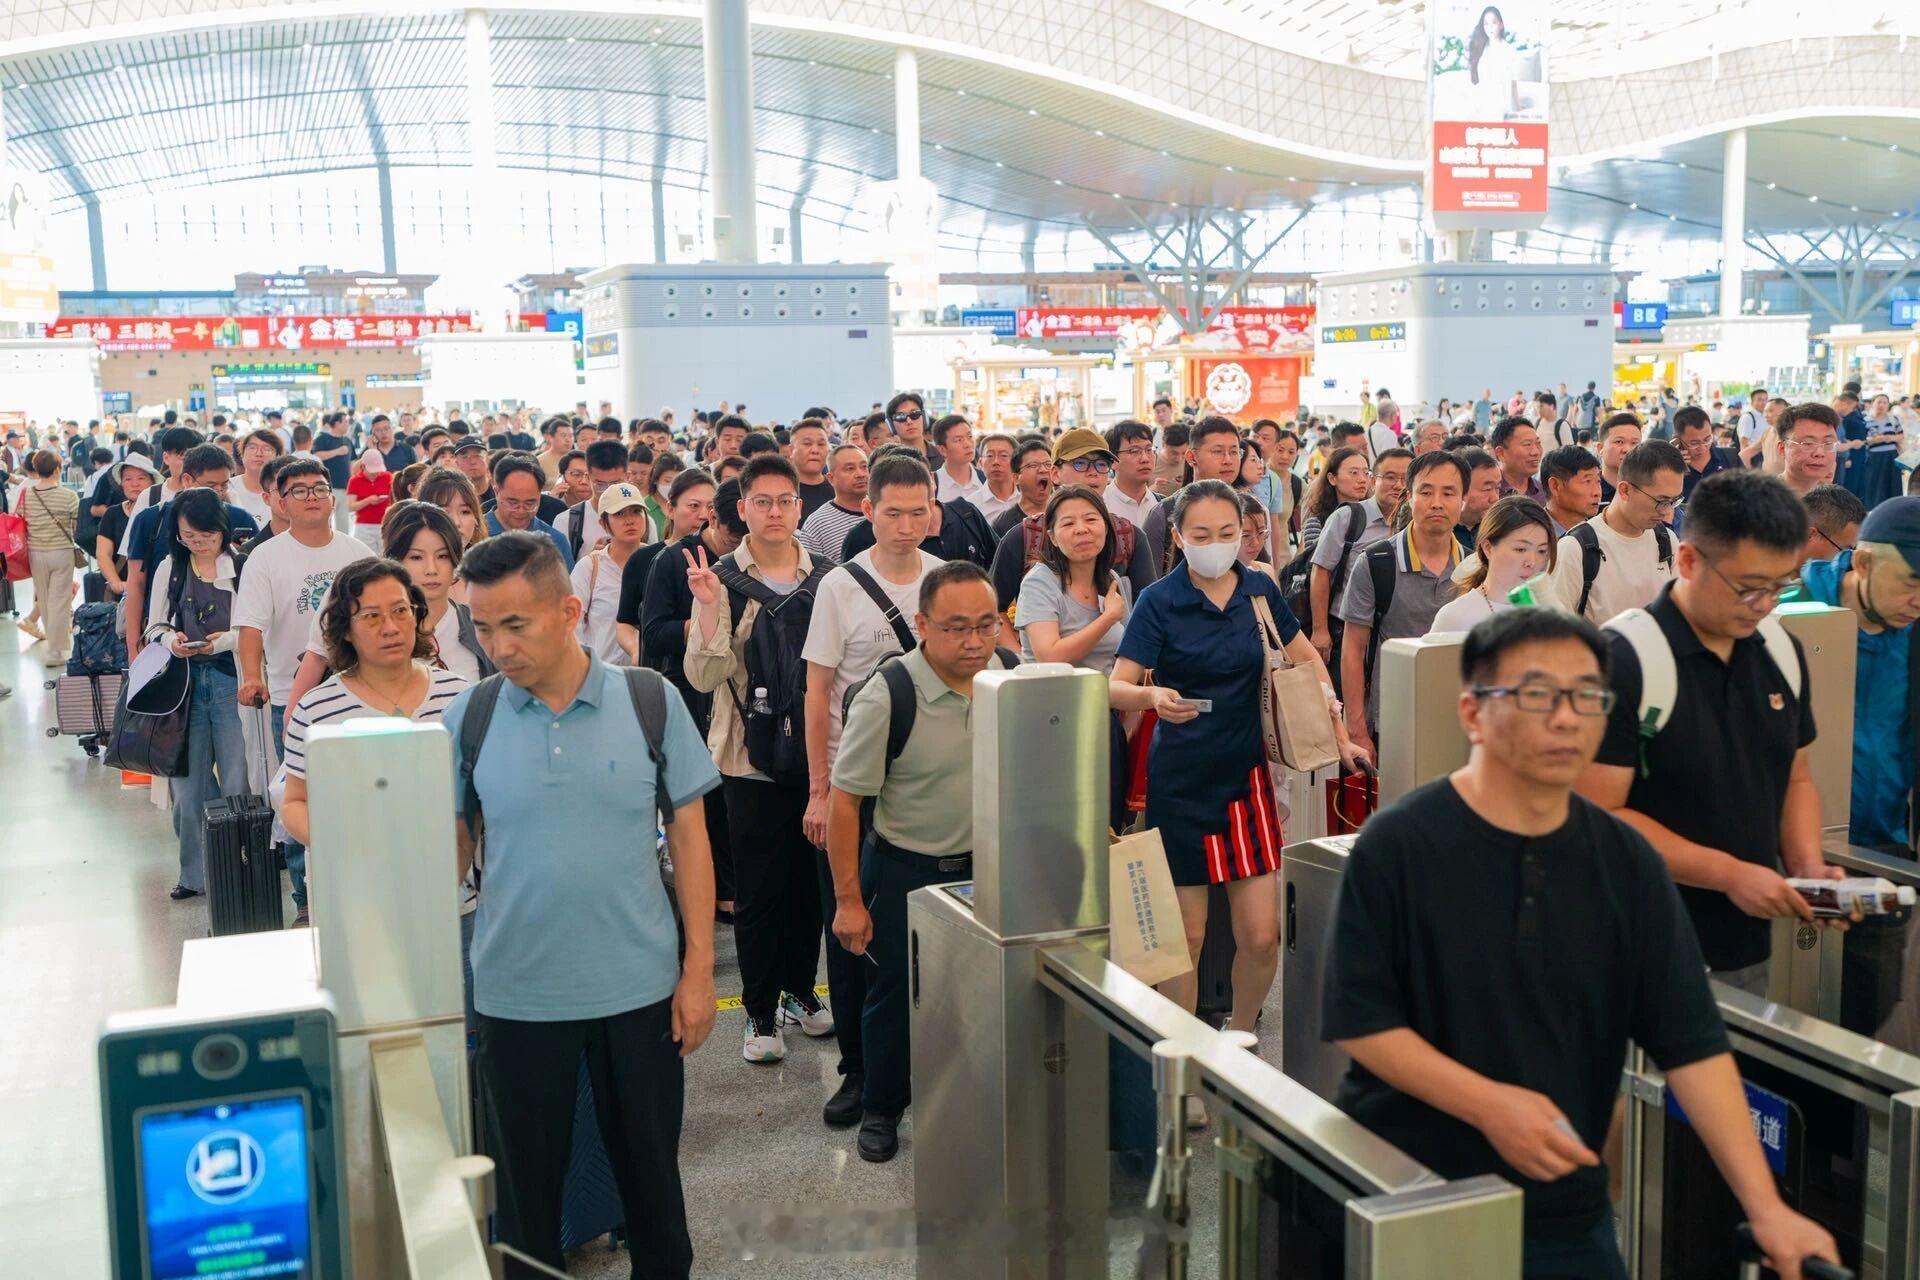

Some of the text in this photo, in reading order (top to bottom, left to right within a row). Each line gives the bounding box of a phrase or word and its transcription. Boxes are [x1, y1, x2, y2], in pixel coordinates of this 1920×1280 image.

[310, 318, 355, 339] 金浩
[296, 588, 310, 614] The
[1262, 677, 1270, 714] Chloé
